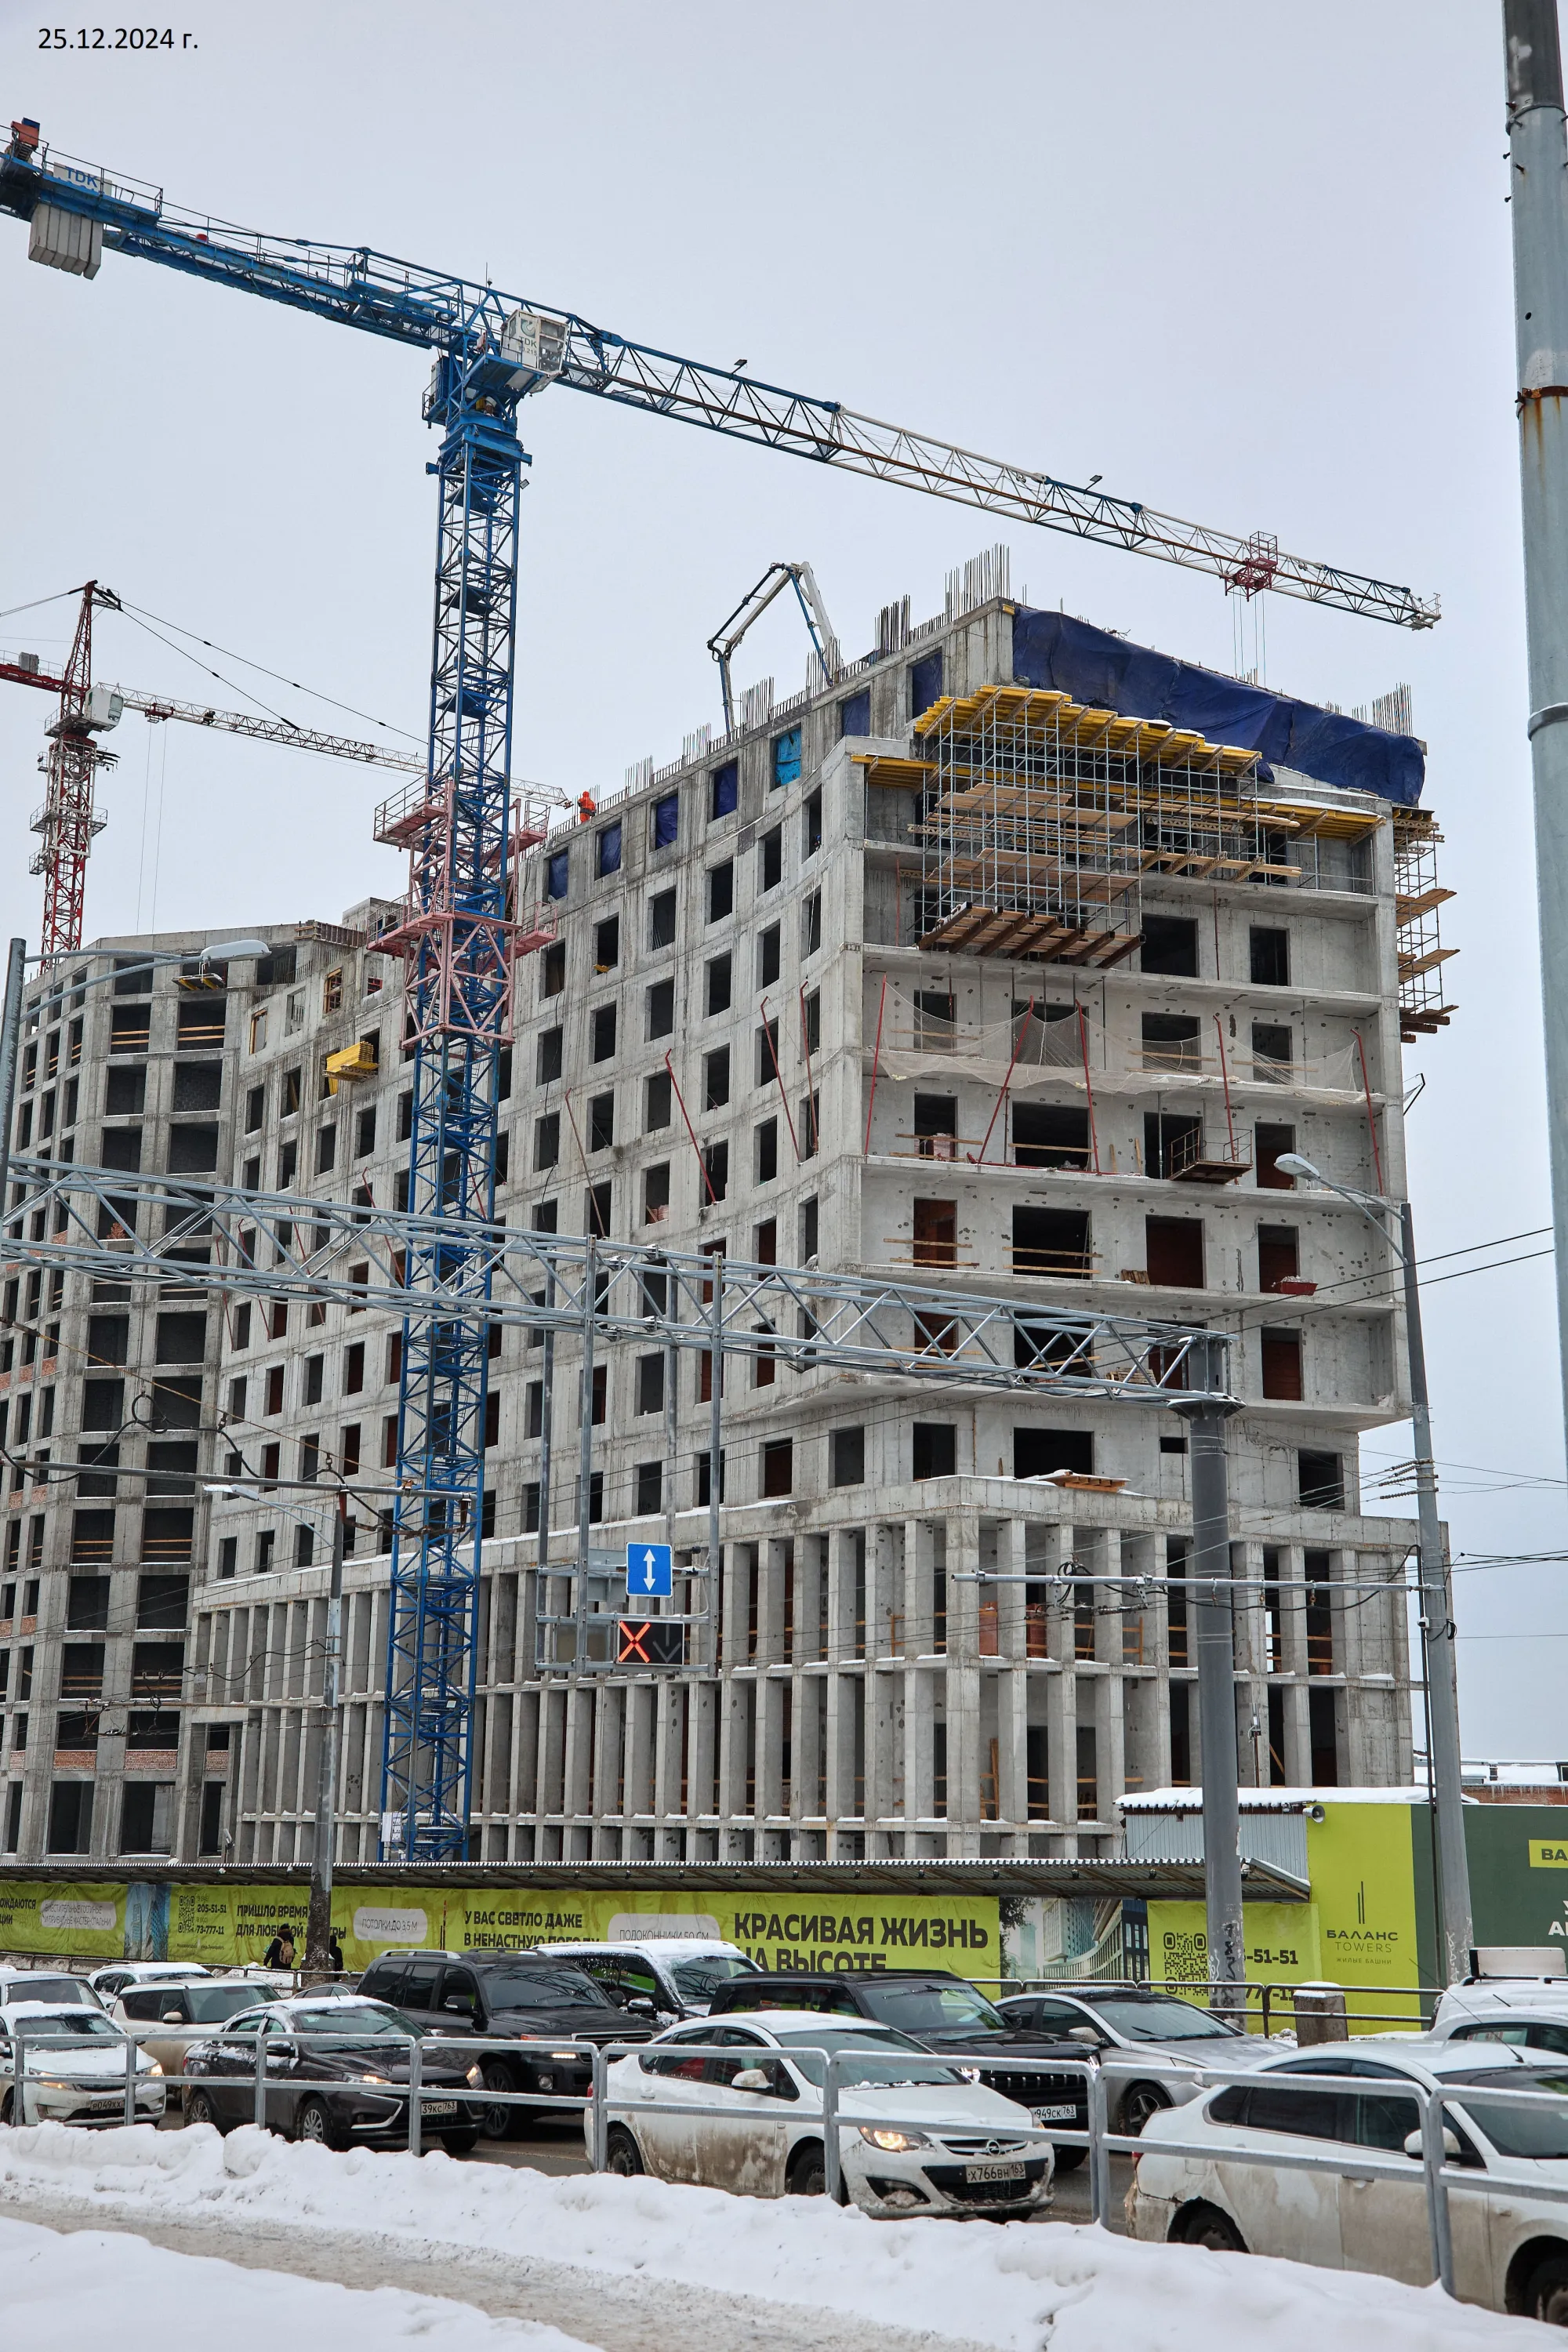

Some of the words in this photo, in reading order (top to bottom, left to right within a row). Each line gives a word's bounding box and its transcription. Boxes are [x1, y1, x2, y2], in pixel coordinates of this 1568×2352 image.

[65, 165, 98, 188] TDK
[519, 336, 537, 349] TDK
[197, 1904, 227, 1913] 205-51-51
[237, 1905, 276, 1917] ПРИШЛО
[278, 1906, 308, 1918] ВРЕМЯ
[361, 1919, 390, 1930] ПОТОЛКИ
[391, 1920, 401, 1932] ДО
[412, 1922, 418, 1931] М
[465, 1911, 472, 1924] У
[474, 1911, 495, 1925] ВАС
[498, 1911, 543, 1927] СВЕТЛО
[545, 1913, 583, 1929] ДАЖЕ
[196, 1926, 224, 1935] 73-777-11
[236, 1924, 255, 1937] ДЛЯ
[256, 1923, 303, 1938] ЛЮБОЙ
[735, 1912, 874, 1945] КРАСИВАЯ
[880, 1917, 989, 1948] ЖИЗНЬ
[1327, 1929, 1399, 1941] БАЛАНС
[464, 1933, 471, 1946] В
[1334, 1941, 1392, 1953] TOWERS
[776, 1948, 887, 1973] ВЫСОТЕ
[1244, 1949, 1298, 1965] -51-51
[1034, 2108, 1062, 2118] 949СК
[1062, 2106, 1074, 2114] 763
[971, 2166, 1009, 2180] Х766ВН
[1010, 2164, 1024, 2175] 163
